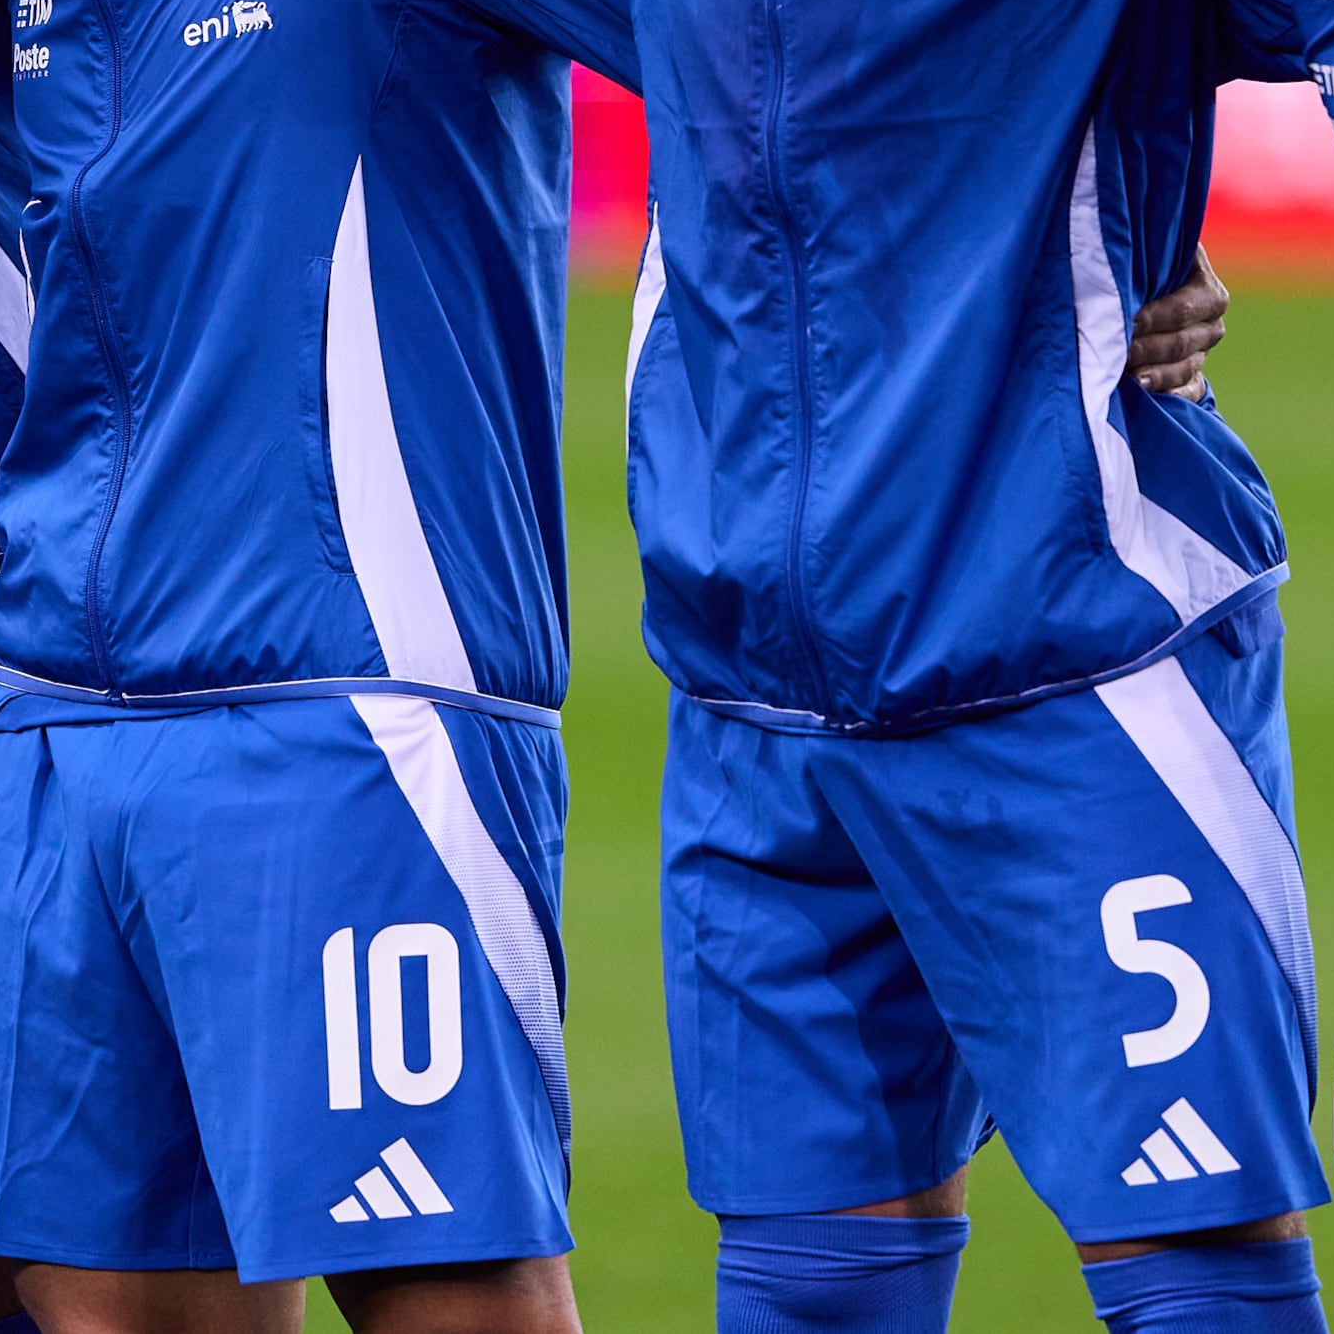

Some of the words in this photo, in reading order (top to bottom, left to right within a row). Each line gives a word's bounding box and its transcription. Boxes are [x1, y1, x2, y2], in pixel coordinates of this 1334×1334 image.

[13, 43, 50, 73] Poste
[183, 7, 229, 46] eni
[322, 923, 463, 1110] 10
[1100, 874, 1211, 1067] 5
